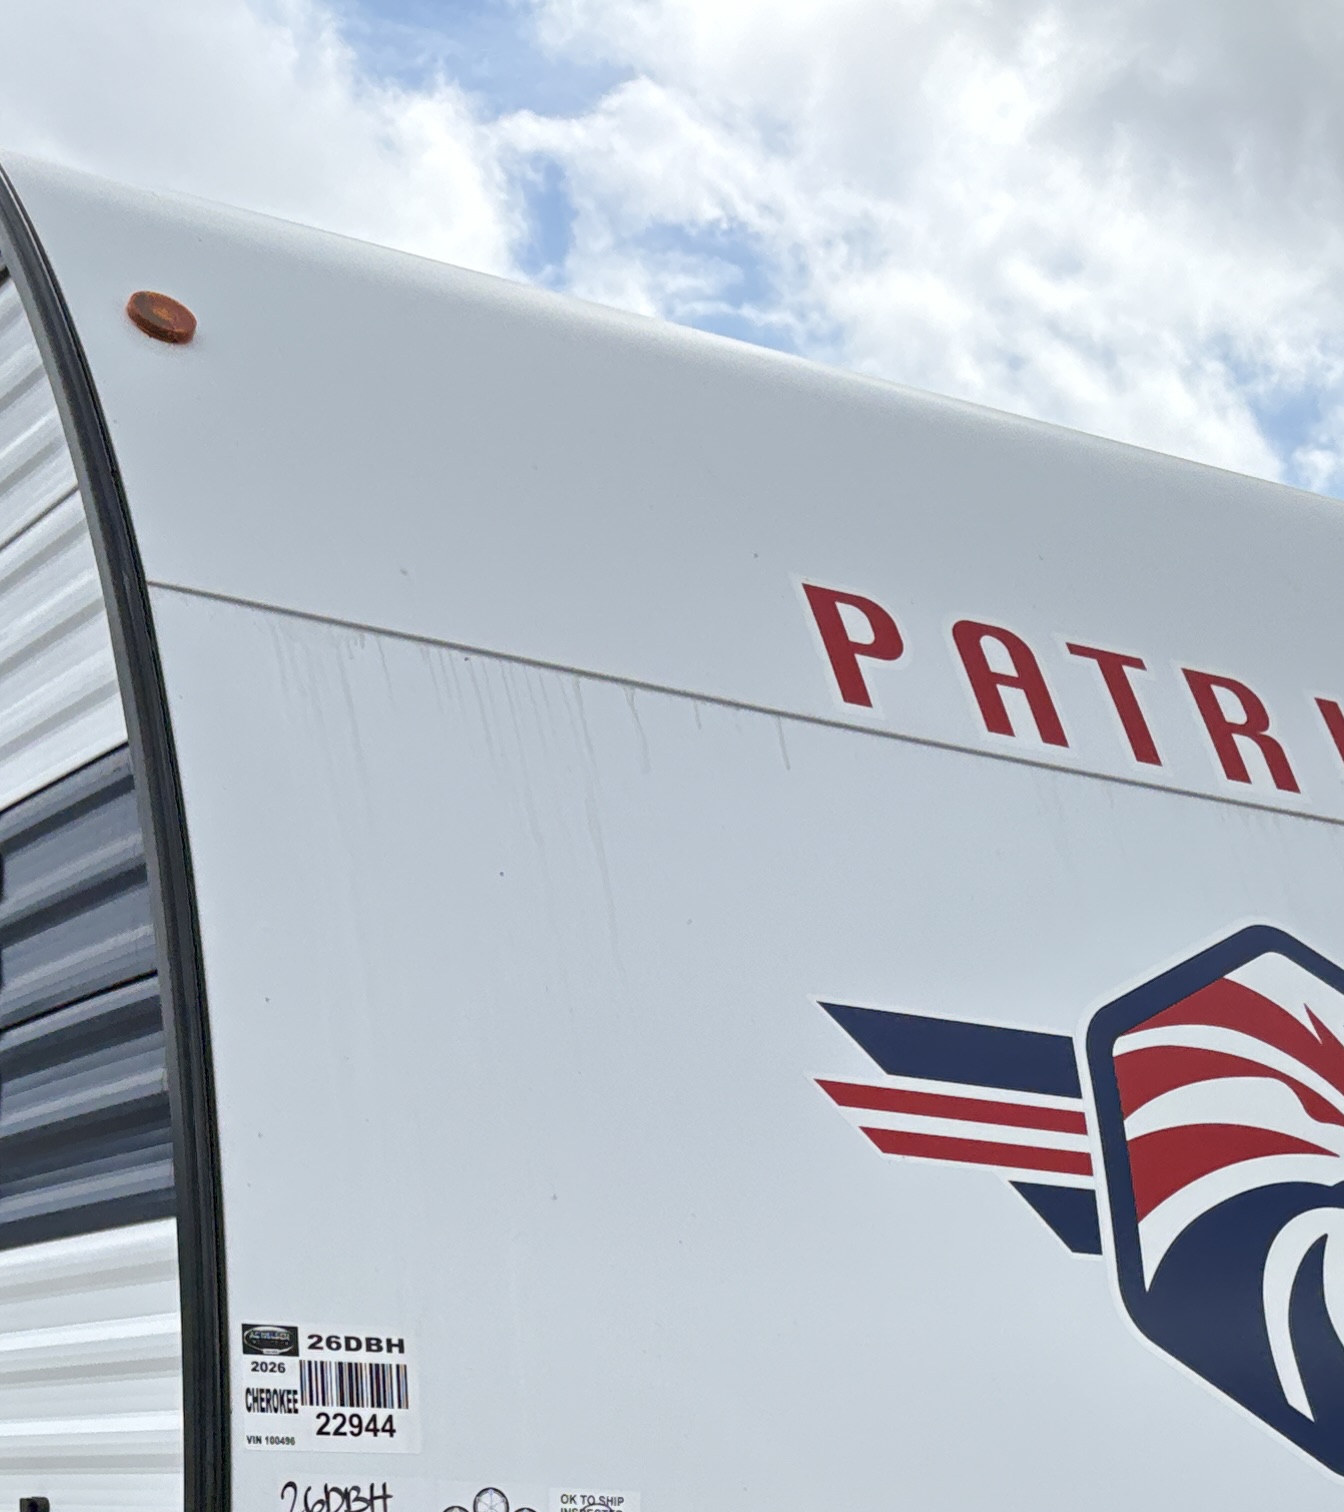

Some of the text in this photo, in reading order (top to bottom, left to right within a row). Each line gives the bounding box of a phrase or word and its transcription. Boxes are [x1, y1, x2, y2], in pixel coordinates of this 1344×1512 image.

[307, 1334, 405, 1354] 26DBH
[251, 1361, 286, 1374] 2026
[245, 1387, 299, 1414] CHEROKEE
[316, 1412, 396, 1437] 22944
[246, 1435, 296, 1446] VIN 100496
[560, 1493, 625, 1506] OK TO SHIP
